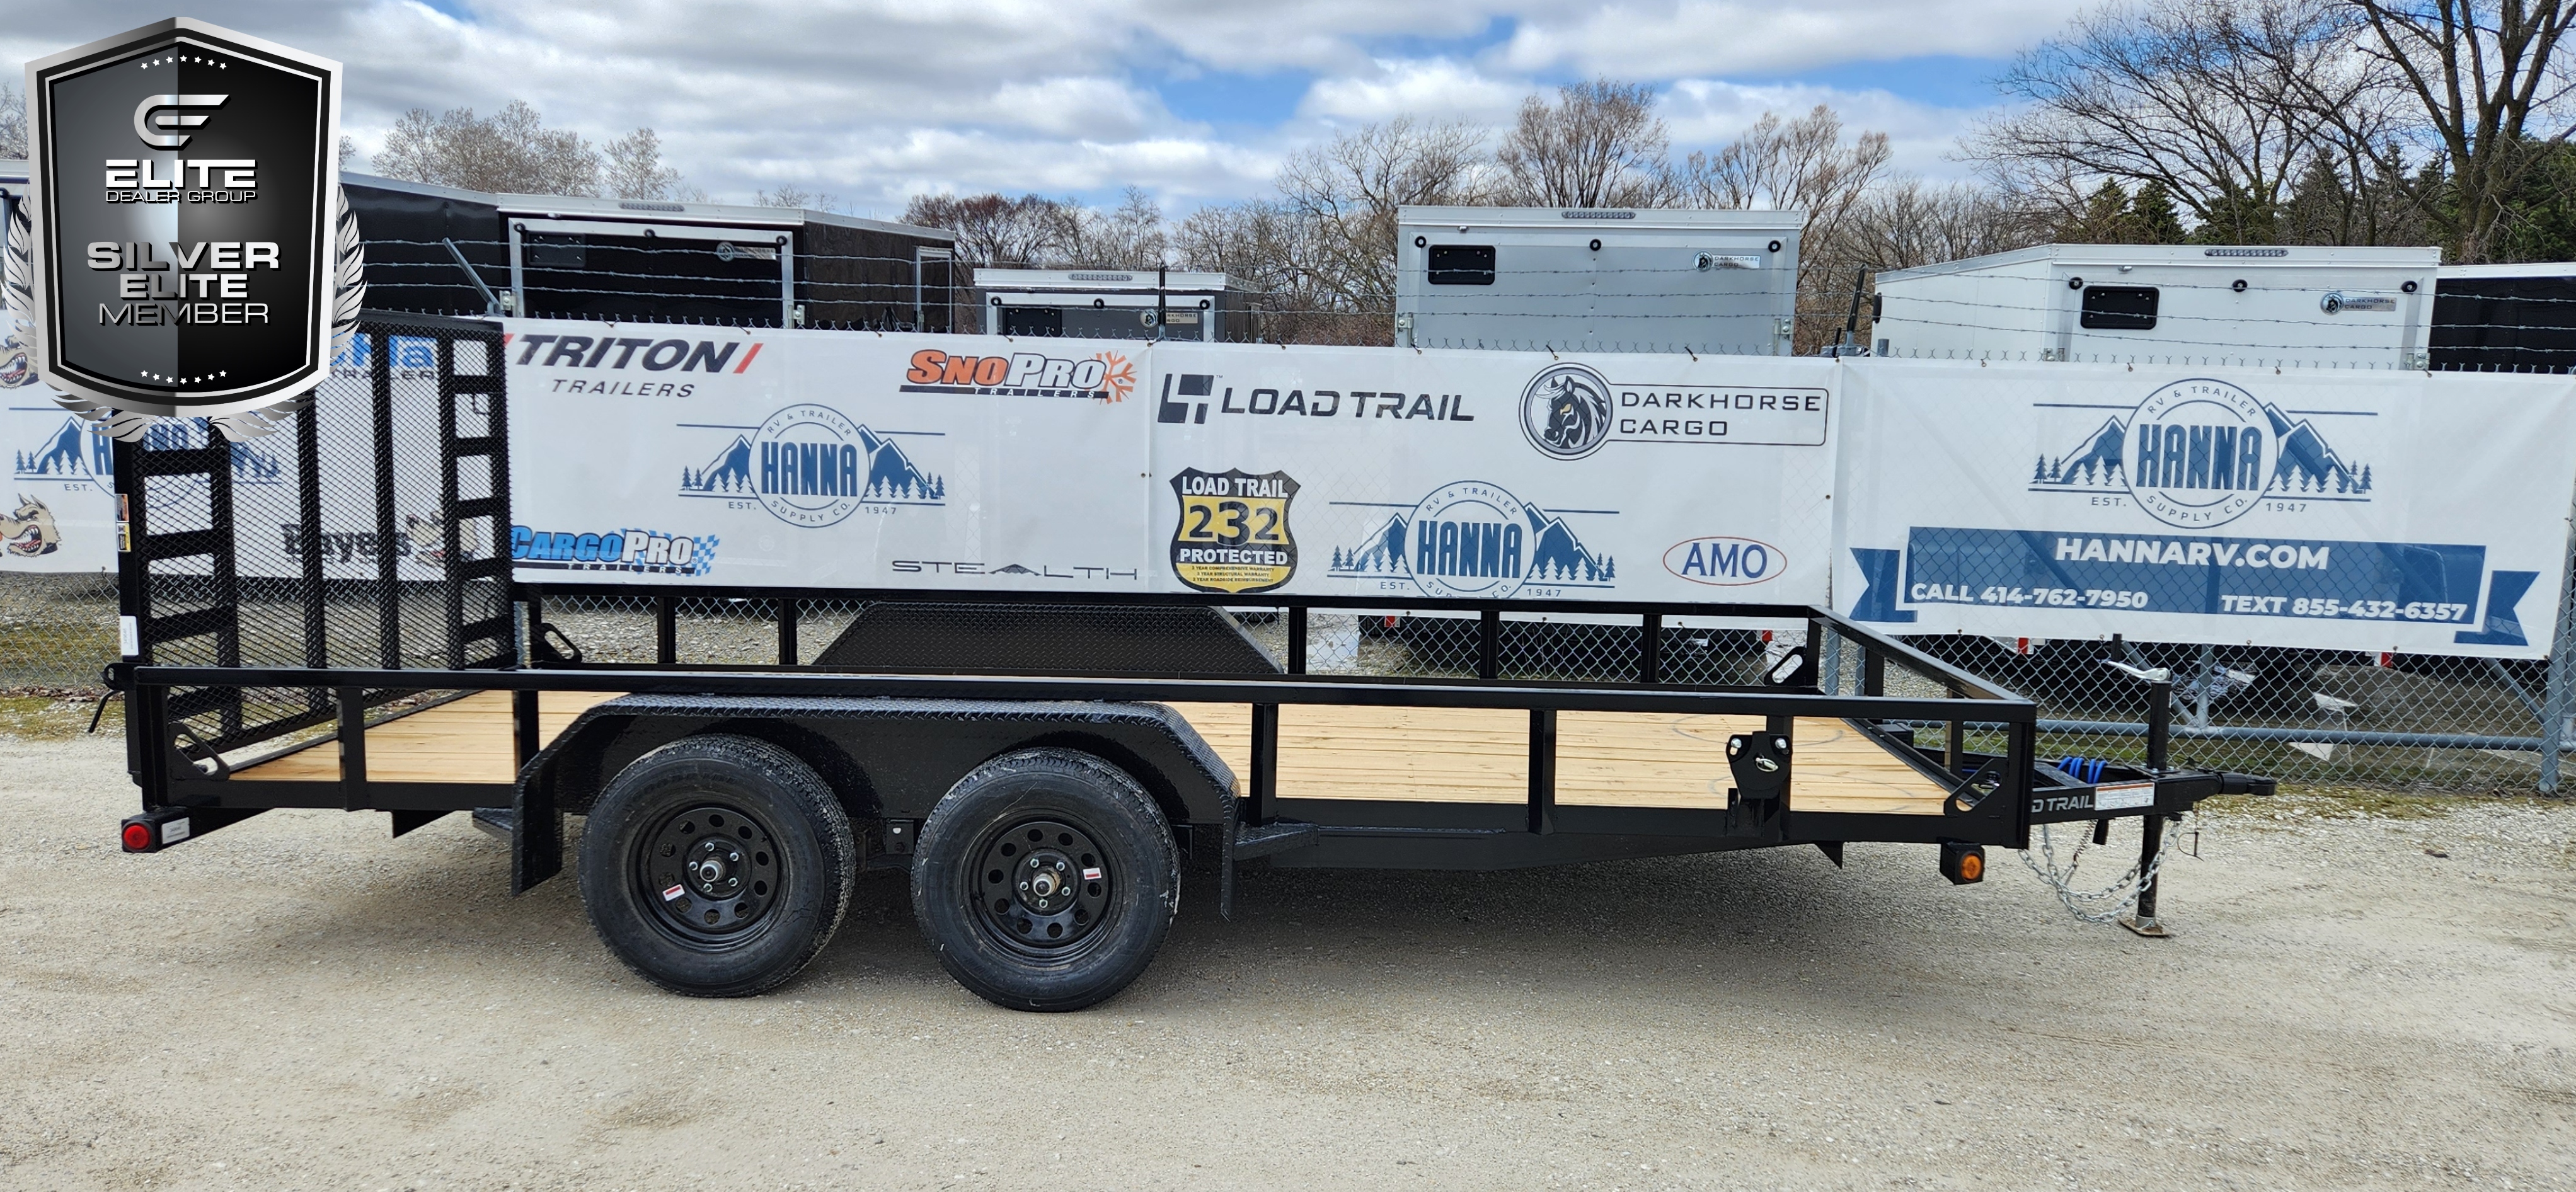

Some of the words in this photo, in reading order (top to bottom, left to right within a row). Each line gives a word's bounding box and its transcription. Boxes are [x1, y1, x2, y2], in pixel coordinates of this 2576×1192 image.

[515, 335, 741, 374] TRITON
[906, 349, 1107, 389] SNOPRO
[551, 379, 695, 398] TRAILERS
[974, 387, 1095, 399] TRAILERS
[1221, 387, 1341, 417] LOAD
[1350, 391, 1476, 421] TRAIL
[1621, 392, 1822, 412] DARKHORSE
[2147, 397, 2165, 415] RV
[2173, 389, 2182, 398] &
[2190, 386, 2257, 417] TRAILER
[767, 419, 781, 434] RV
[800, 410, 852, 437] TRAILER
[1619, 418, 1728, 436] CARGO
[2136, 423, 2263, 491] HANNA
[761, 440, 858, 498] HANNA
[64, 484, 93, 492] EST.
[1182, 476, 1229, 496] LOAD
[1234, 478, 1289, 498] TRAIL
[728, 501, 757, 510] EST.
[771, 500, 824, 522] SUPPLY
[832, 502, 851, 517] CO.
[865, 506, 898, 515] 1947
[1426, 497, 1440, 512] RV
[1447, 490, 1455, 498] &
[1463, 487, 1518, 515] TRAILER
[2091, 496, 2127, 507] EST.
[2146, 495, 2212, 522] SUPPLY
[2224, 498, 2248, 515] CO.
[2266, 502, 2308, 513] 1947
[1188, 500, 1279, 546] 232
[1179, 547, 1289, 566] PROTECTED
[1416, 520, 1522, 578] HANNA
[2055, 537, 2330, 570] HANNARV.COM
[567, 563, 682, 574] TRAILERS
[891, 559, 1137, 580] STEALTH
[1681, 542, 1768, 579] AMO
[1379, 581, 1410, 591] EST.
[1527, 588, 1561, 598] 1947
[1911, 582, 1974, 603] CALL
[1979, 586, 2149, 609] 414-762-7950
[2221, 594, 2287, 614] TEXT
[2291, 597, 2468, 622] 855-432-6357
[2046, 795, 2094, 811] TRAIL
